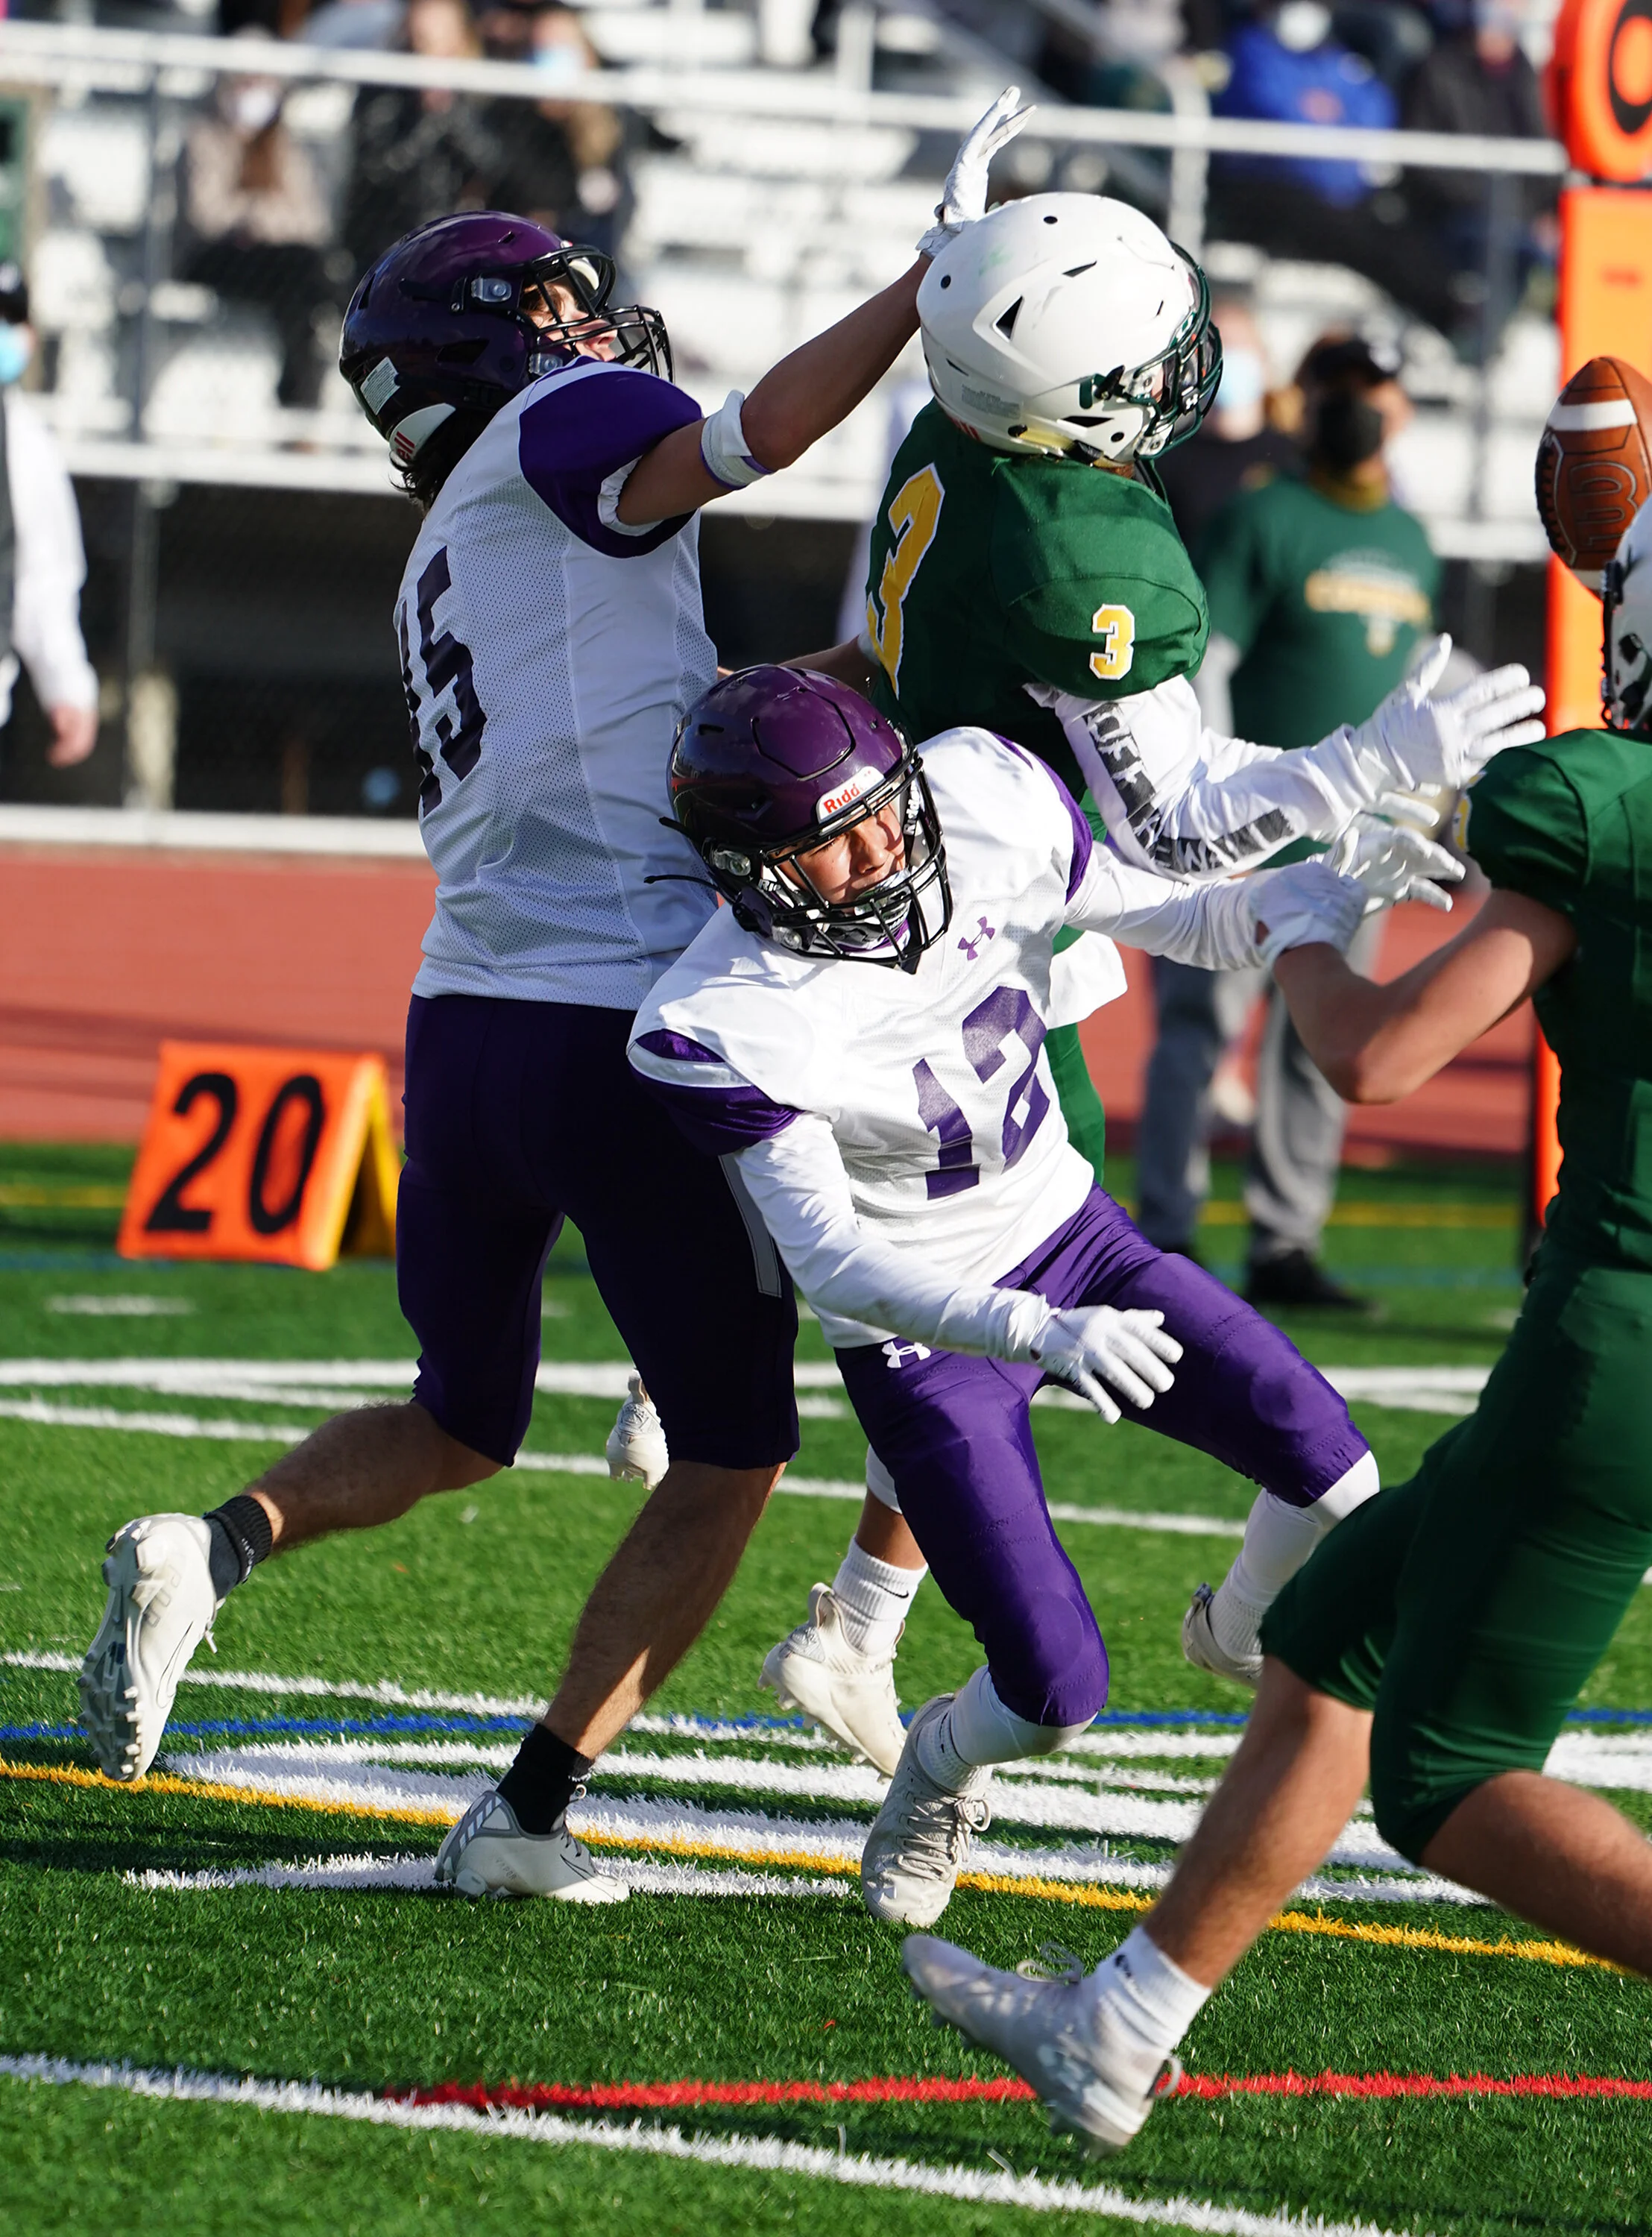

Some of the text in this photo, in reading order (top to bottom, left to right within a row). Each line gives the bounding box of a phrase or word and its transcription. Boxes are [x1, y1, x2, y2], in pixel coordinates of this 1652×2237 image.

[1089, 603, 1135, 680] 3
[1086, 708, 1149, 785] OFF
[823, 772, 871, 814] Ridd
[912, 985, 1051, 1201] 12
[145, 1071, 326, 1235] 20
